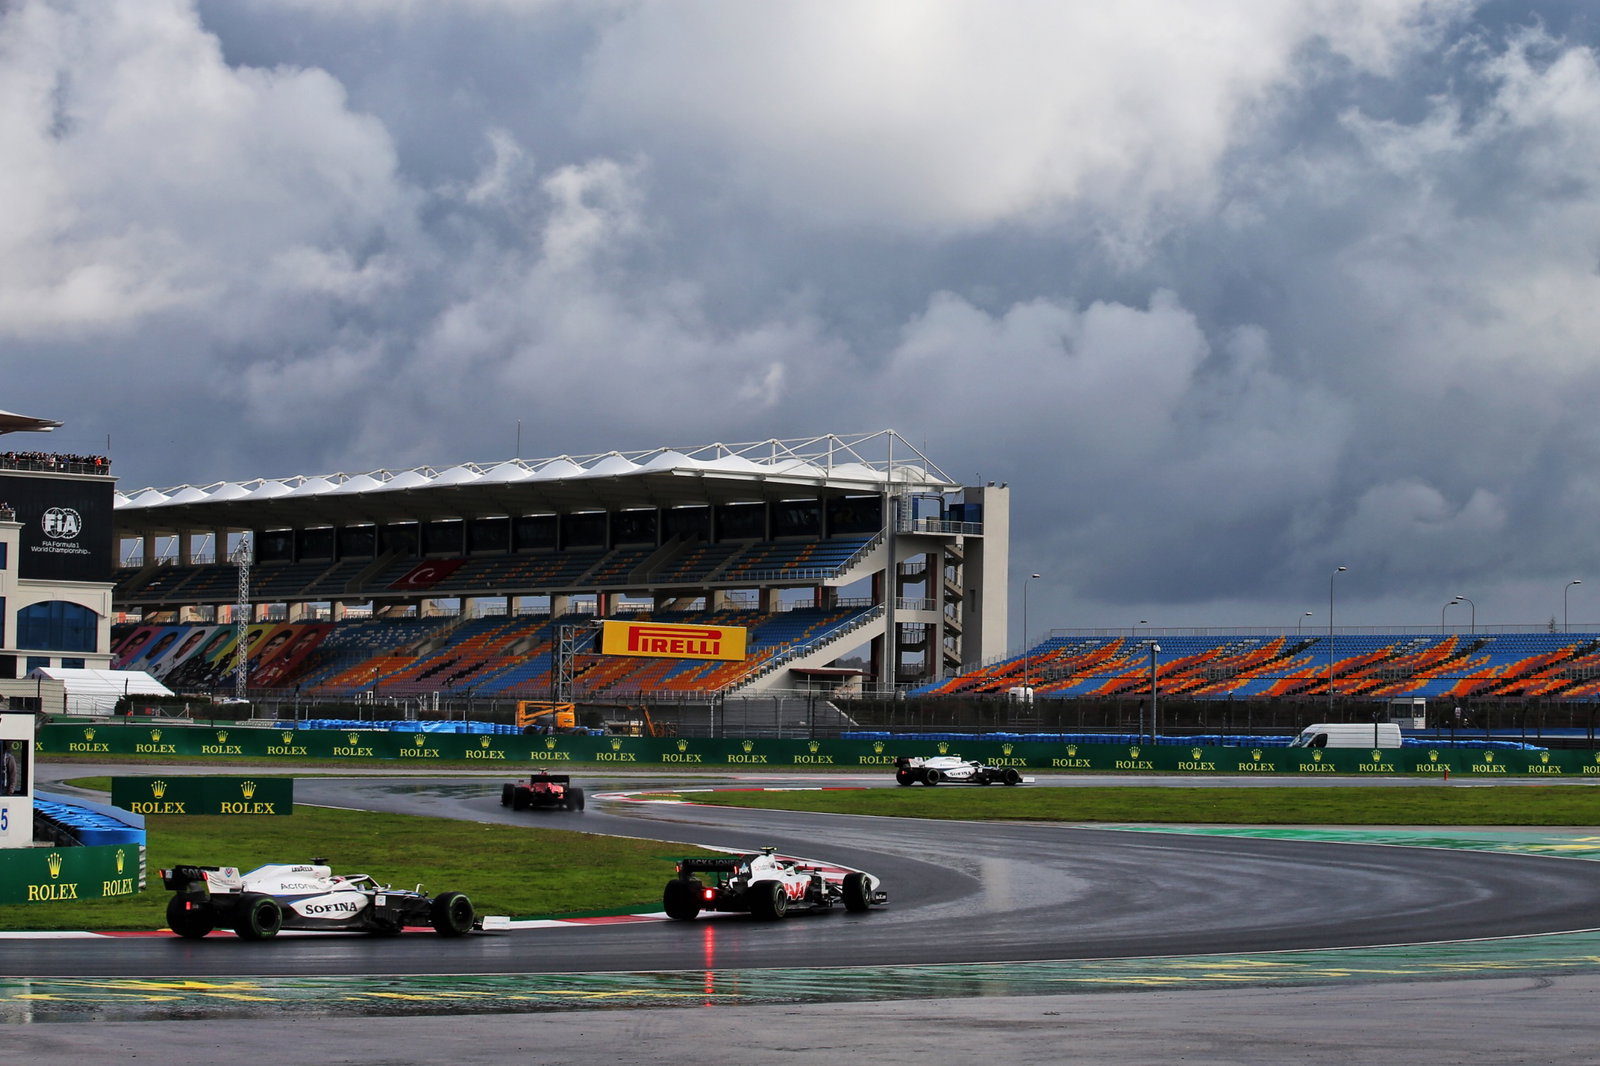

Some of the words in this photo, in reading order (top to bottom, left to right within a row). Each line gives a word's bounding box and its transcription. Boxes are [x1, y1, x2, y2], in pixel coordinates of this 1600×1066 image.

[52, 541, 76, 549] Formula
[628, 626, 722, 655] PIRELLI
[70, 742, 109, 751] ROLEX
[136, 744, 176, 753] ROLEX
[202, 745, 242, 754] ROLEX
[268, 746, 307, 755] ROLEX
[334, 746, 372, 755] ROLEX
[400, 748, 439, 757] ROLEX
[466, 750, 504, 759] ROLEX
[531, 751, 569, 760] ROLEX
[597, 752, 635, 761] ROLEX
[663, 753, 701, 762] ROLEX
[728, 754, 767, 763] ROLEX
[795, 755, 832, 764] ROLEX
[989, 757, 1026, 766] ROLEX
[1053, 758, 1090, 767] ROLEX
[1116, 760, 1152, 769] ROLEX
[1179, 761, 1215, 770] ROLEX
[1239, 762, 1273, 771] ROLEX
[1300, 763, 1335, 772] ROLEX
[1360, 763, 1393, 772] ROLEX
[1417, 763, 1450, 772] ROLEX
[1473, 764, 1505, 773] ROLEX
[1529, 765, 1561, 774] ROLEX
[131, 802, 185, 815] ROLEX
[220, 802, 275, 815] ROLEX
[28, 883, 78, 901] ROLEX
[102, 878, 133, 897] ROLEX
[305, 901, 358, 915] SOFINA
